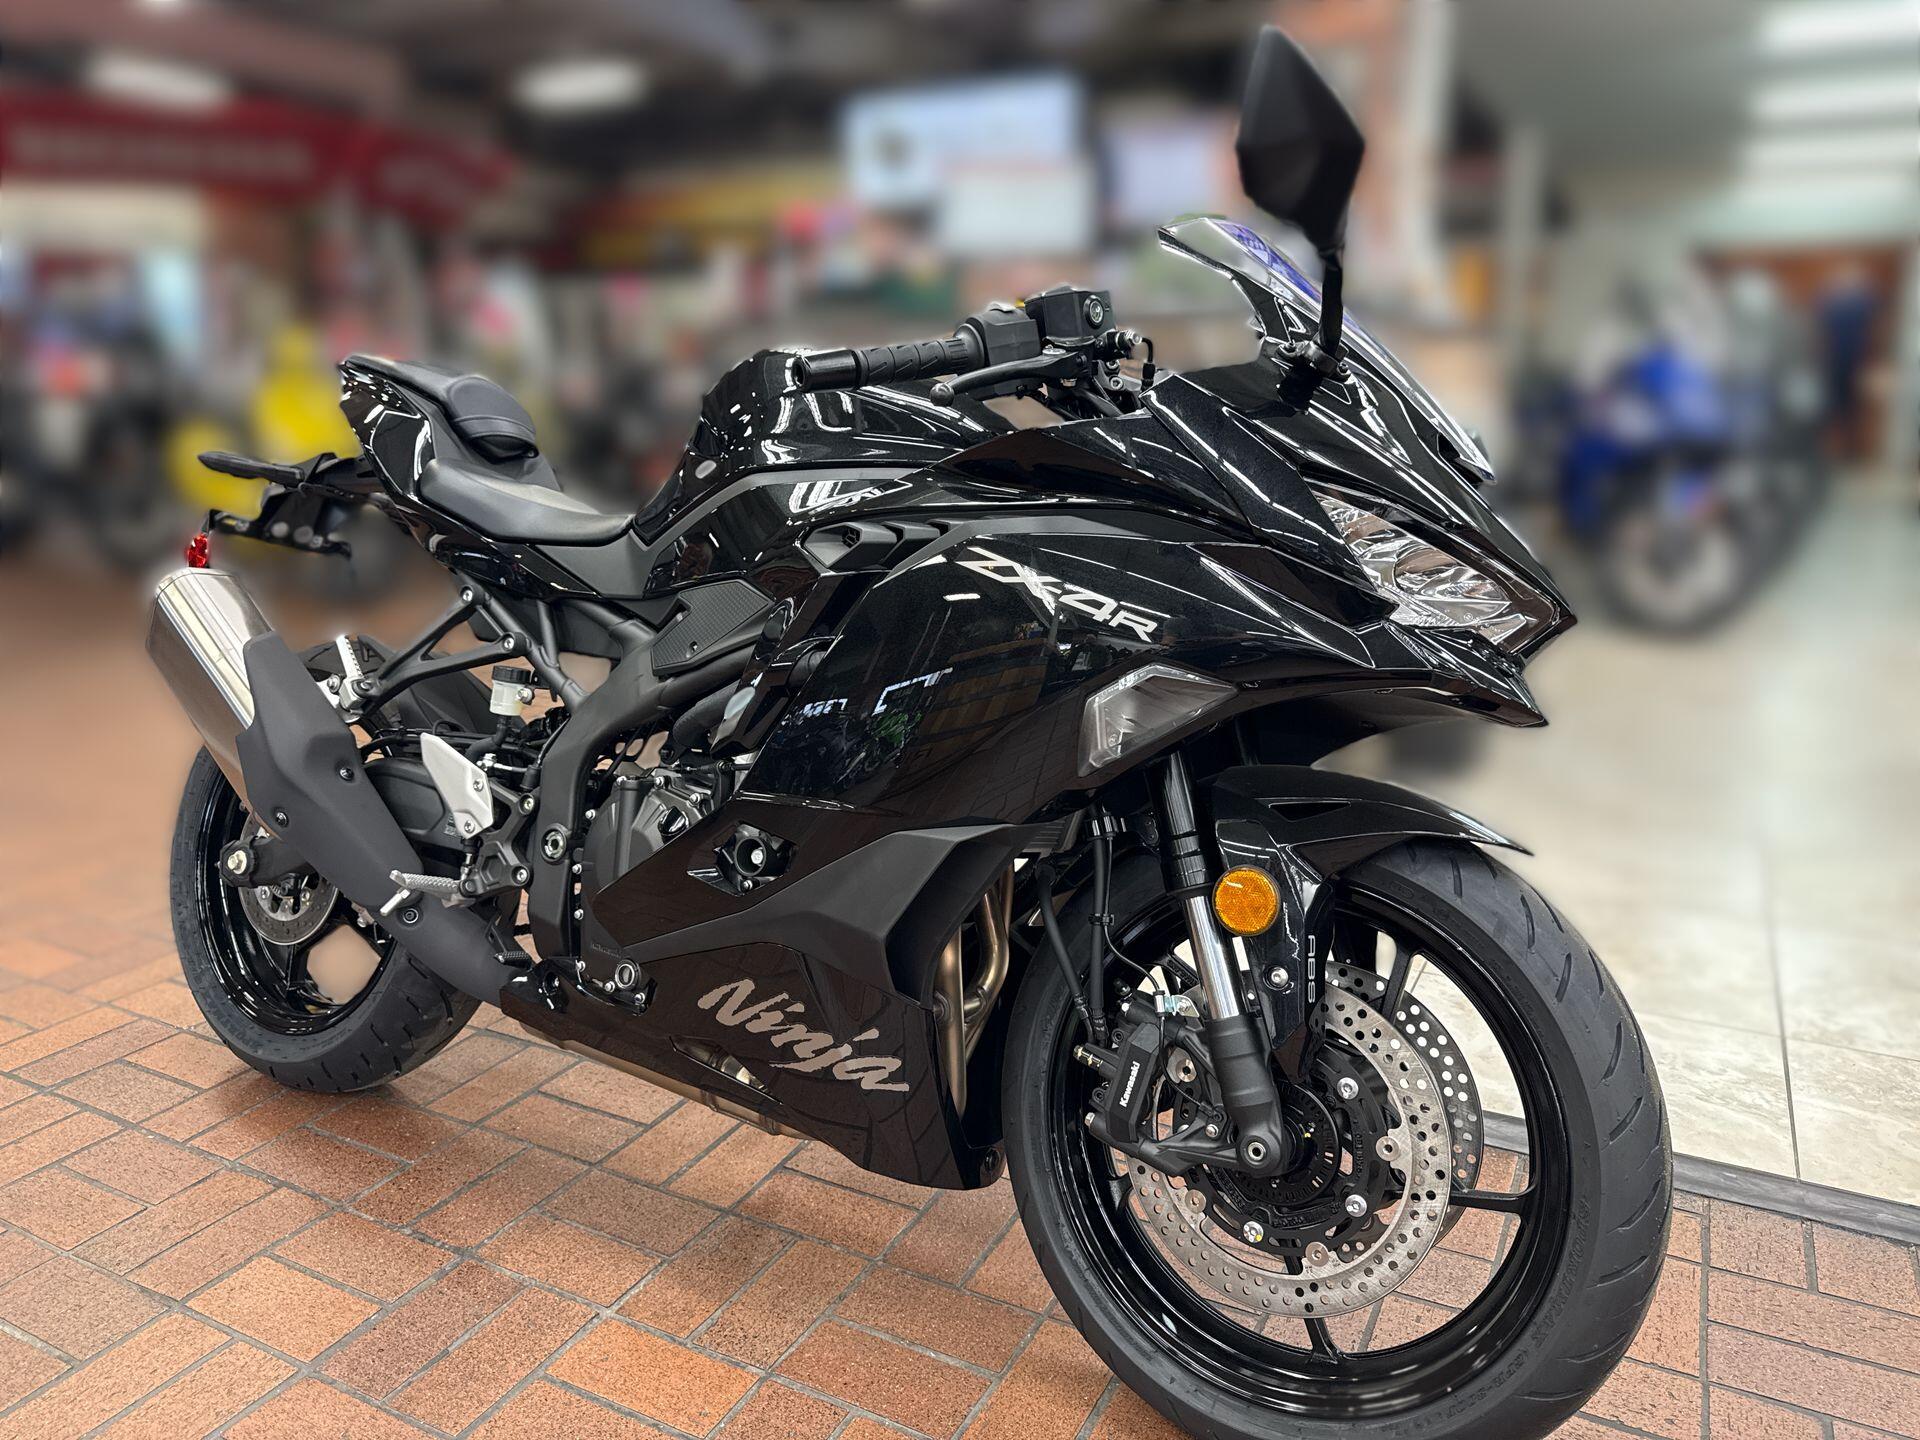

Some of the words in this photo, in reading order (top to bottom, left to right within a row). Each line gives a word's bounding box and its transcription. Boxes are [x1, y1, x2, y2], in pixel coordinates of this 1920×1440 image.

[1307, 935, 1316, 1003] ABS
[697, 978, 910, 1092] Ninja
[1120, 1061, 1140, 1107] Kawasaki
